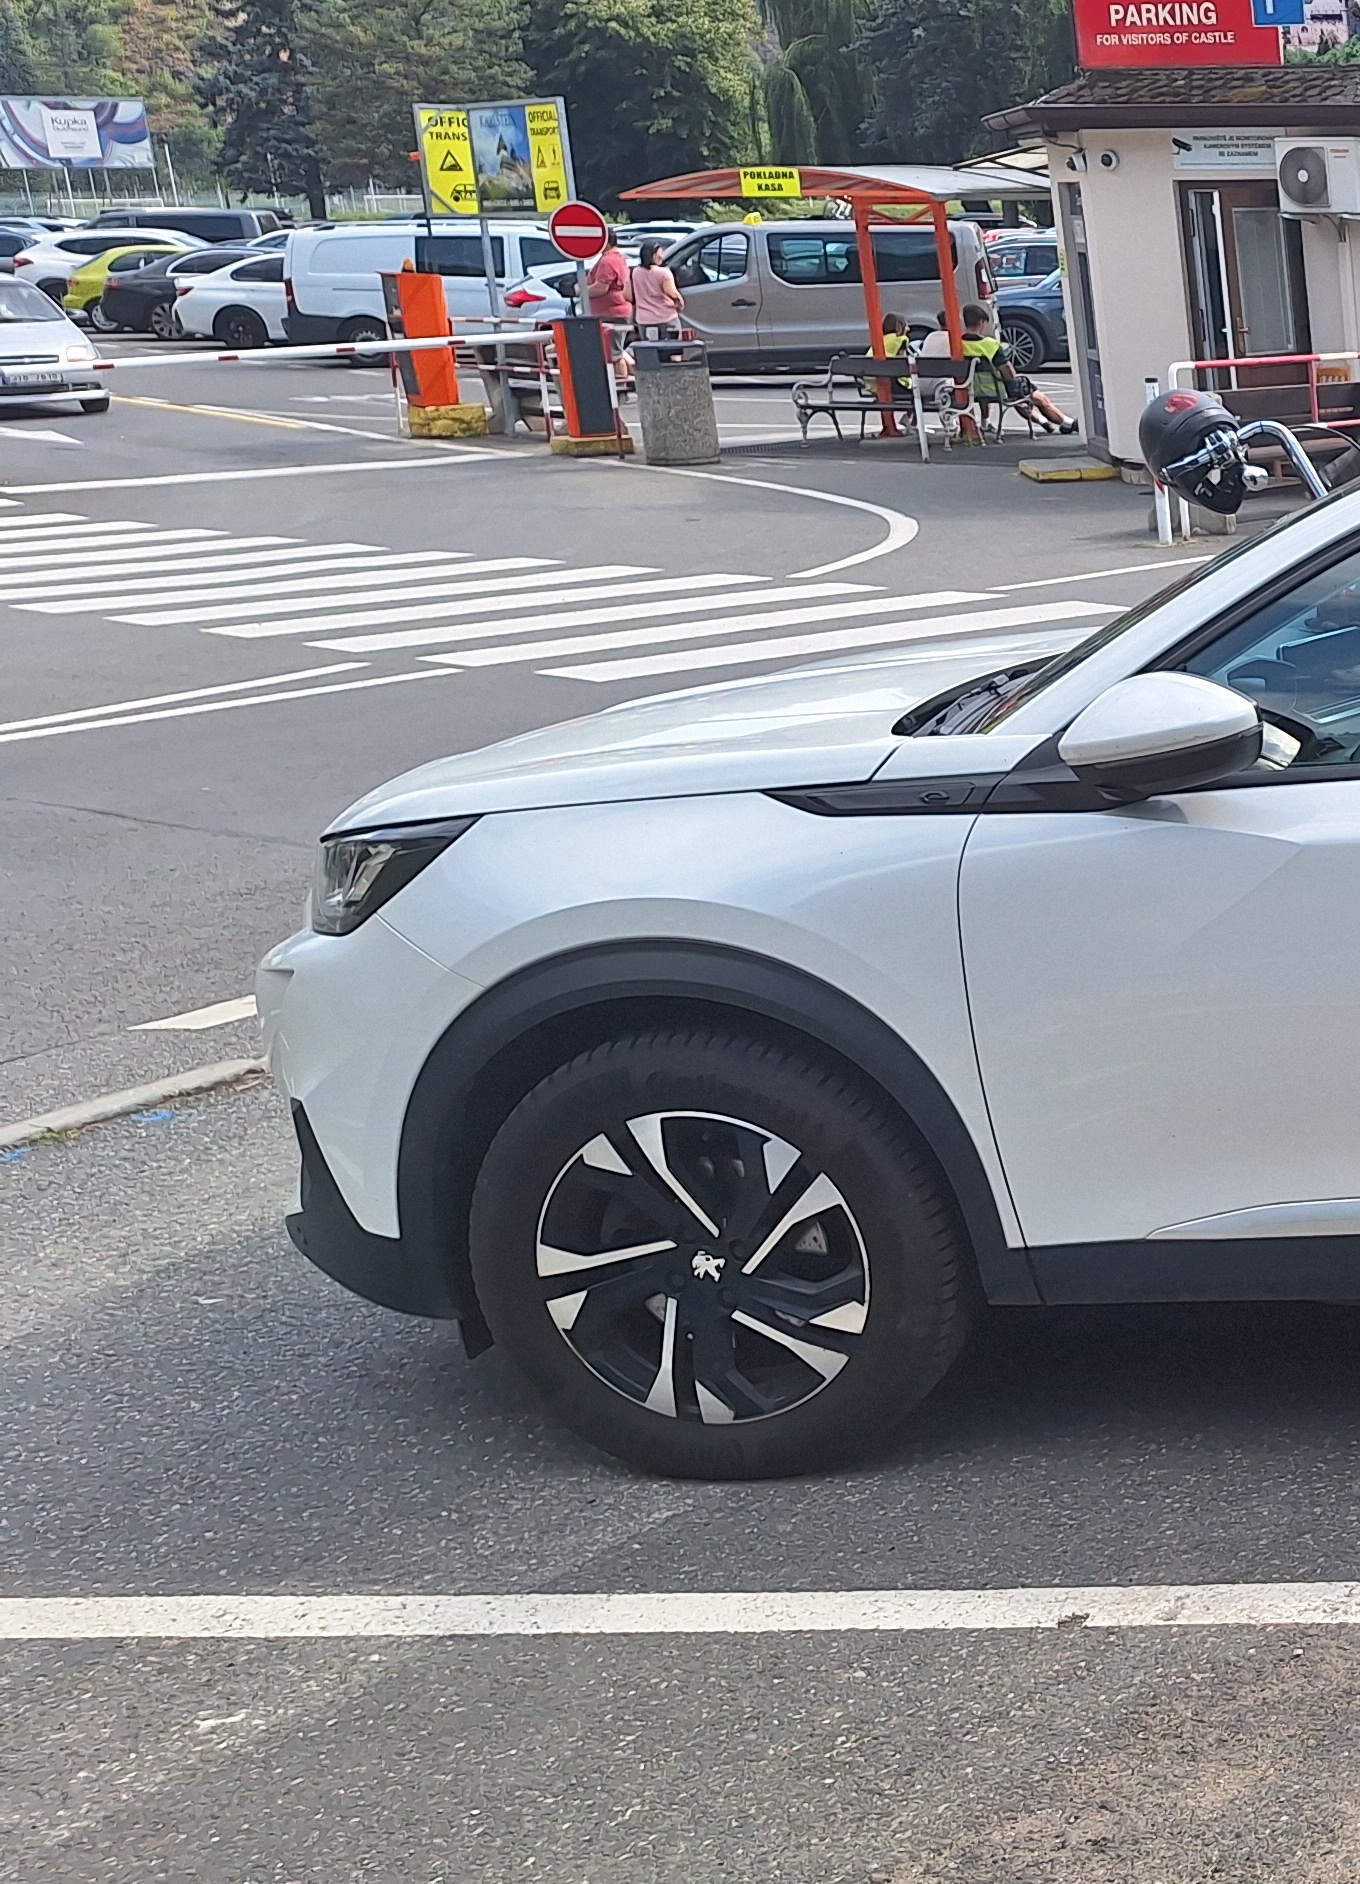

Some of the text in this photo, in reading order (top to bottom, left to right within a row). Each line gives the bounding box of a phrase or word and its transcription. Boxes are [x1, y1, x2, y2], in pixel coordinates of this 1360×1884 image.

[1109, 2, 1217, 27] PARKING
[1096, 31, 1235, 46] FOR VISITORS OF CASTLE
[528, 110, 558, 123] OFFICIAL
[743, 170, 795, 179] POKLADNA
[757, 183, 783, 191] KASA
